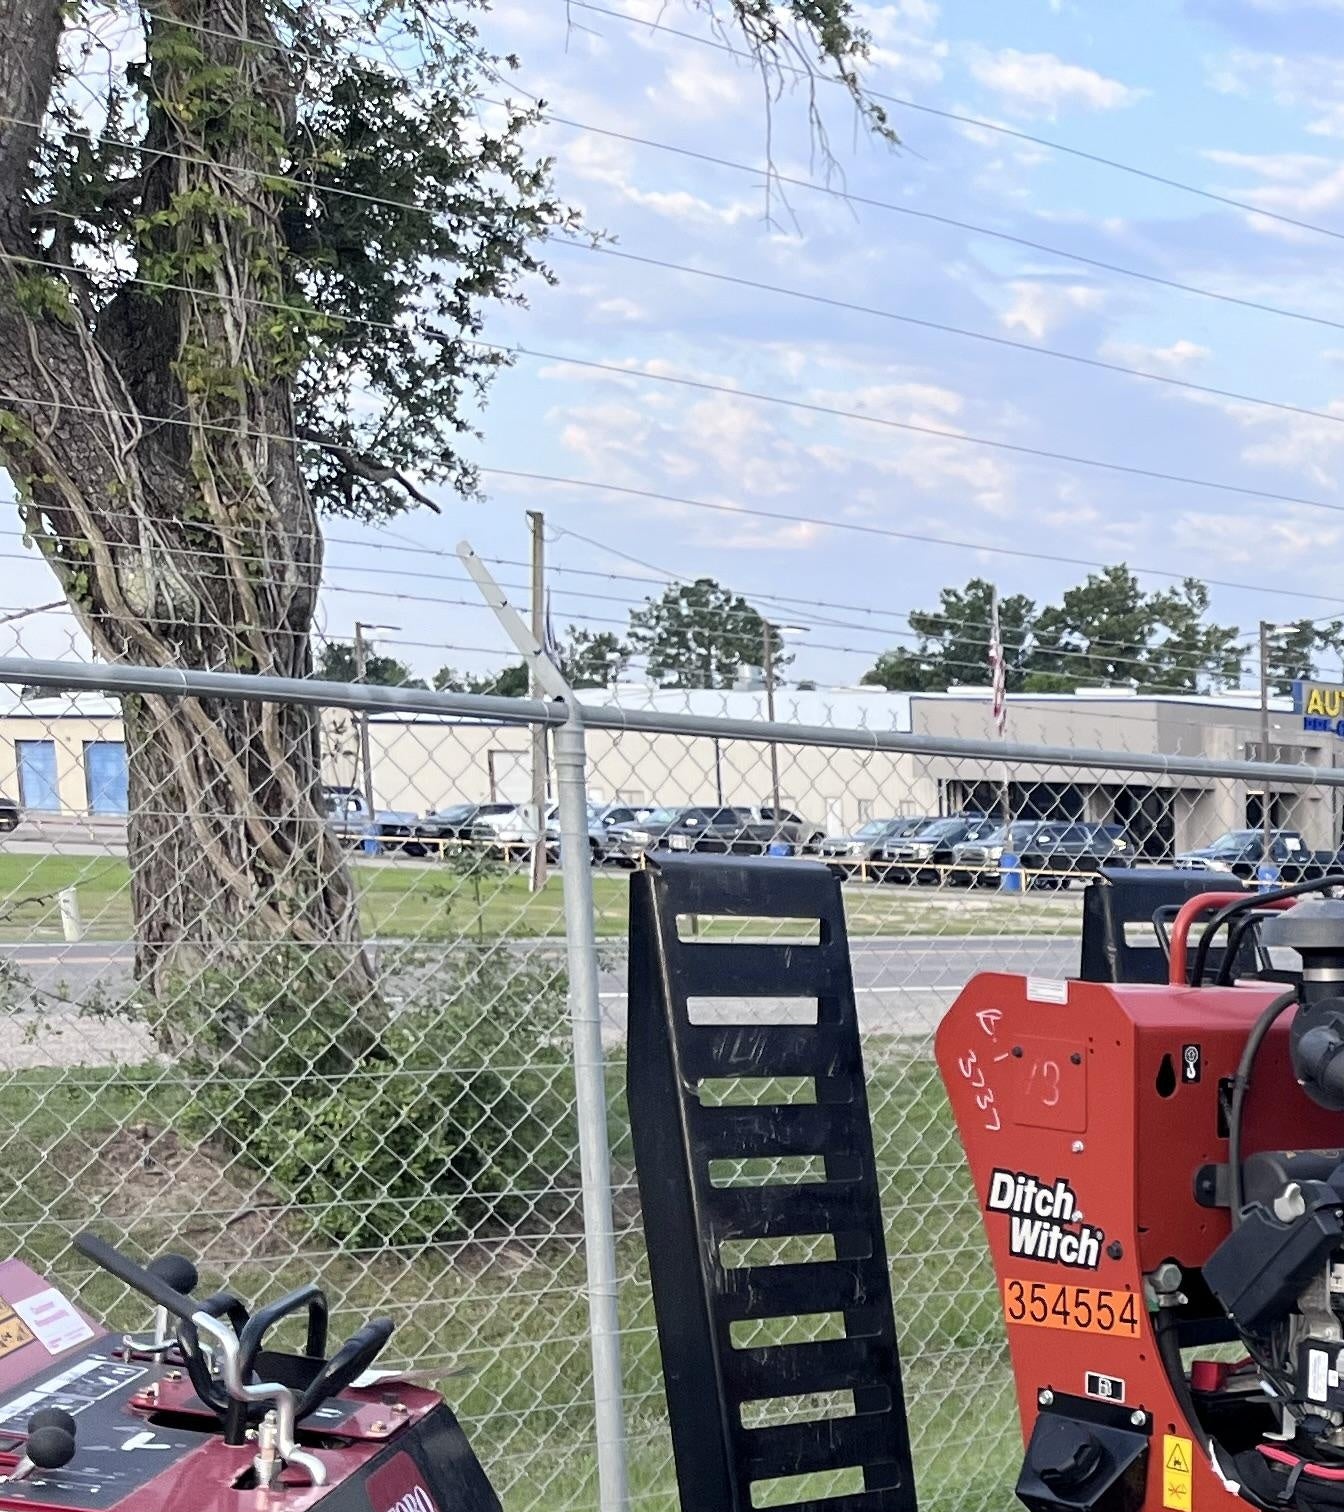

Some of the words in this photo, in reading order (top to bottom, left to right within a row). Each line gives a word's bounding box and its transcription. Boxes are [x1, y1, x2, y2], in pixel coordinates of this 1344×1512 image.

[989, 1171, 1075, 1221] Ditch
[1011, 1216, 1101, 1267] Witch
[1007, 1280, 1138, 1334] 354554
